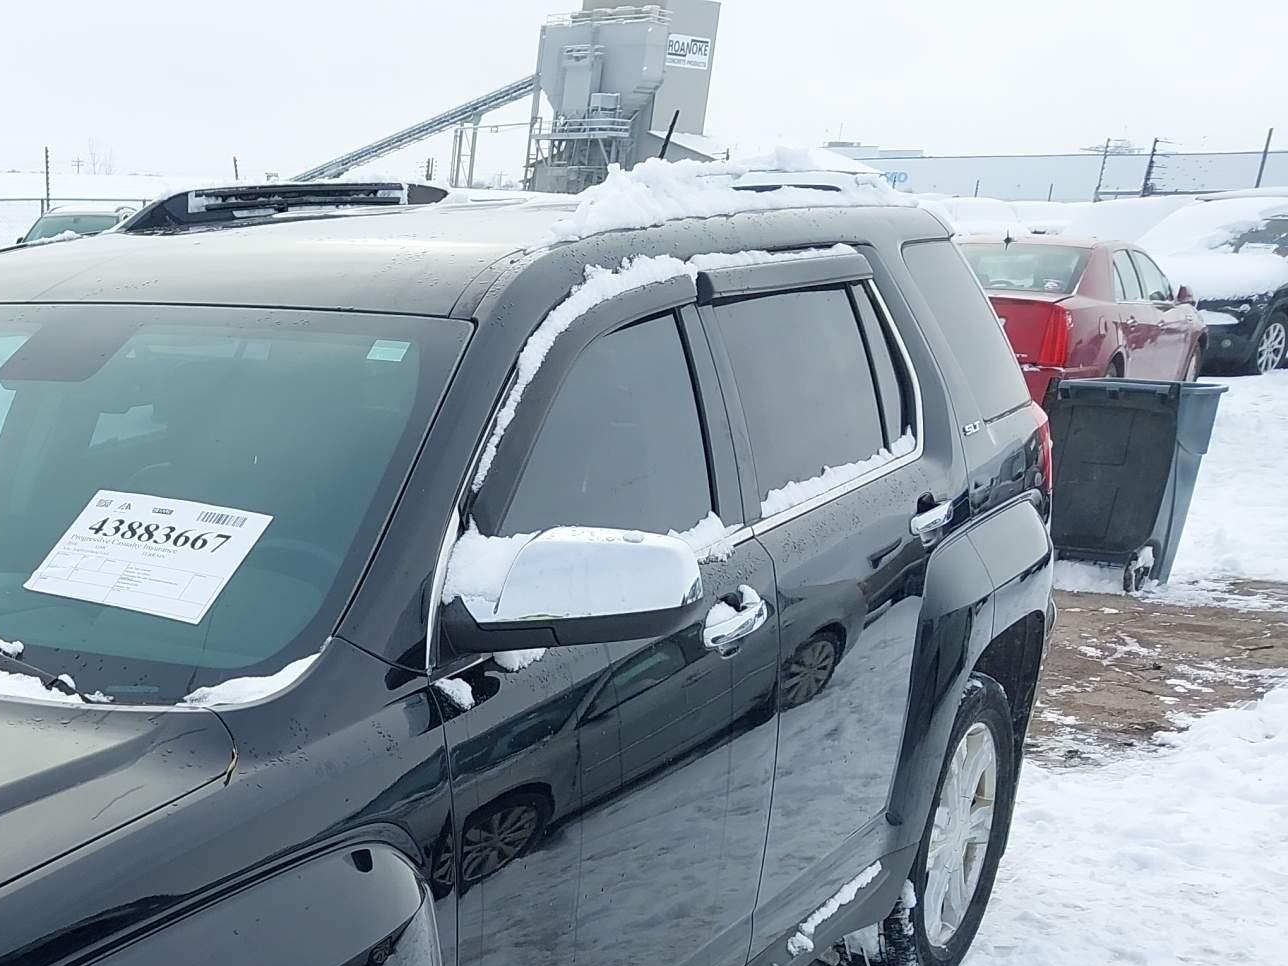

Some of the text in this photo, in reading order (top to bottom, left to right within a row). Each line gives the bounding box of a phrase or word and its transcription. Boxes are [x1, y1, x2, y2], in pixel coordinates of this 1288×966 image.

[668, 40, 709, 56] ROANOKE
[963, 420, 981, 436] SLT
[70, 533, 110, 545] Progressive
[111, 538, 141, 549] Casualty
[143, 543, 178, 555] Insurance
[88, 516, 232, 554] 43883667
